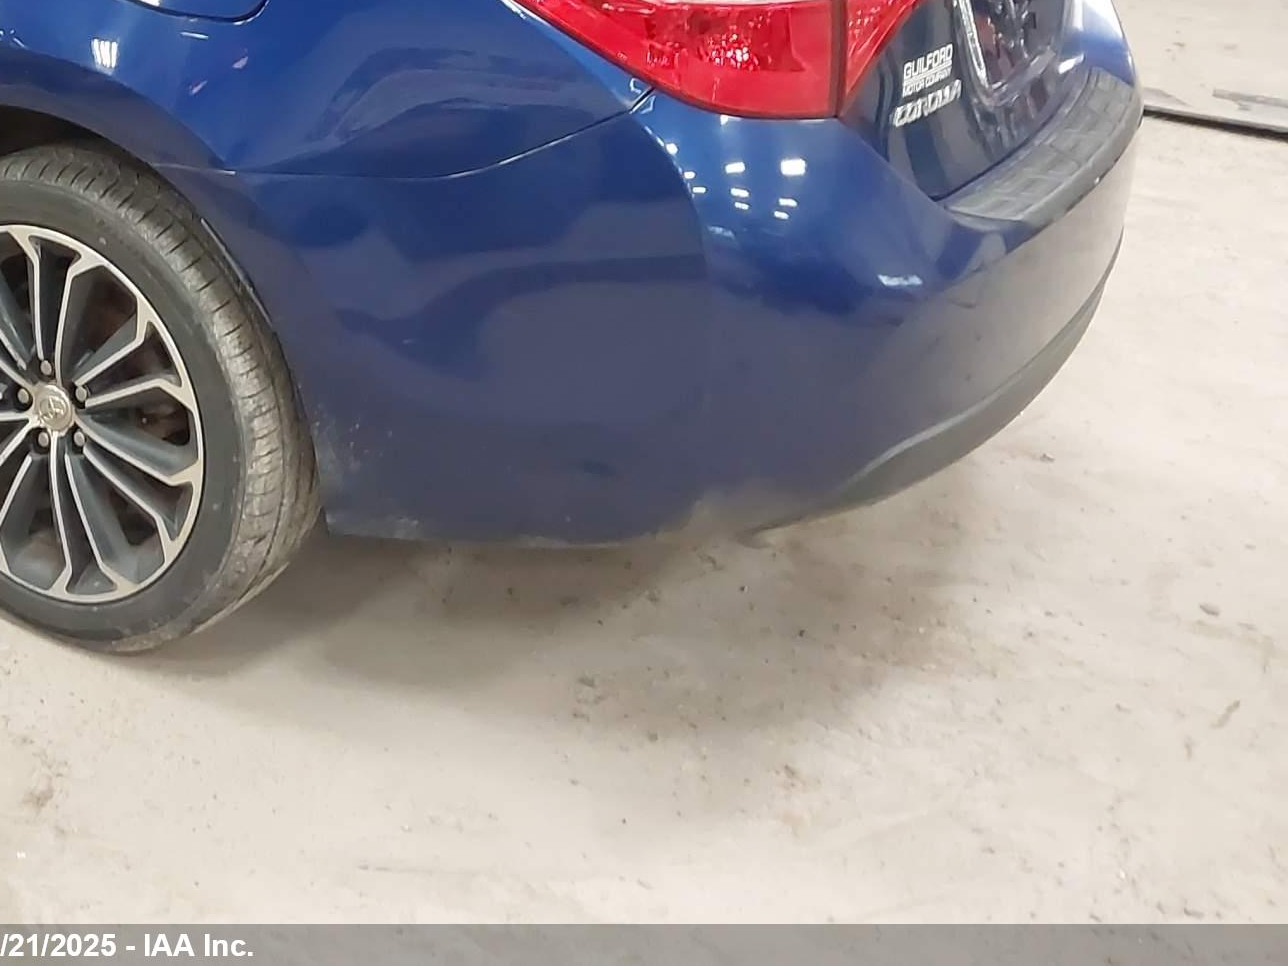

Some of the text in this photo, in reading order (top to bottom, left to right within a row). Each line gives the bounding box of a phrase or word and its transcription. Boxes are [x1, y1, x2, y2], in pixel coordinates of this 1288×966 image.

[903, 43, 953, 81] GUILFORD
[902, 66, 952, 98] MOTOR COMPANY
